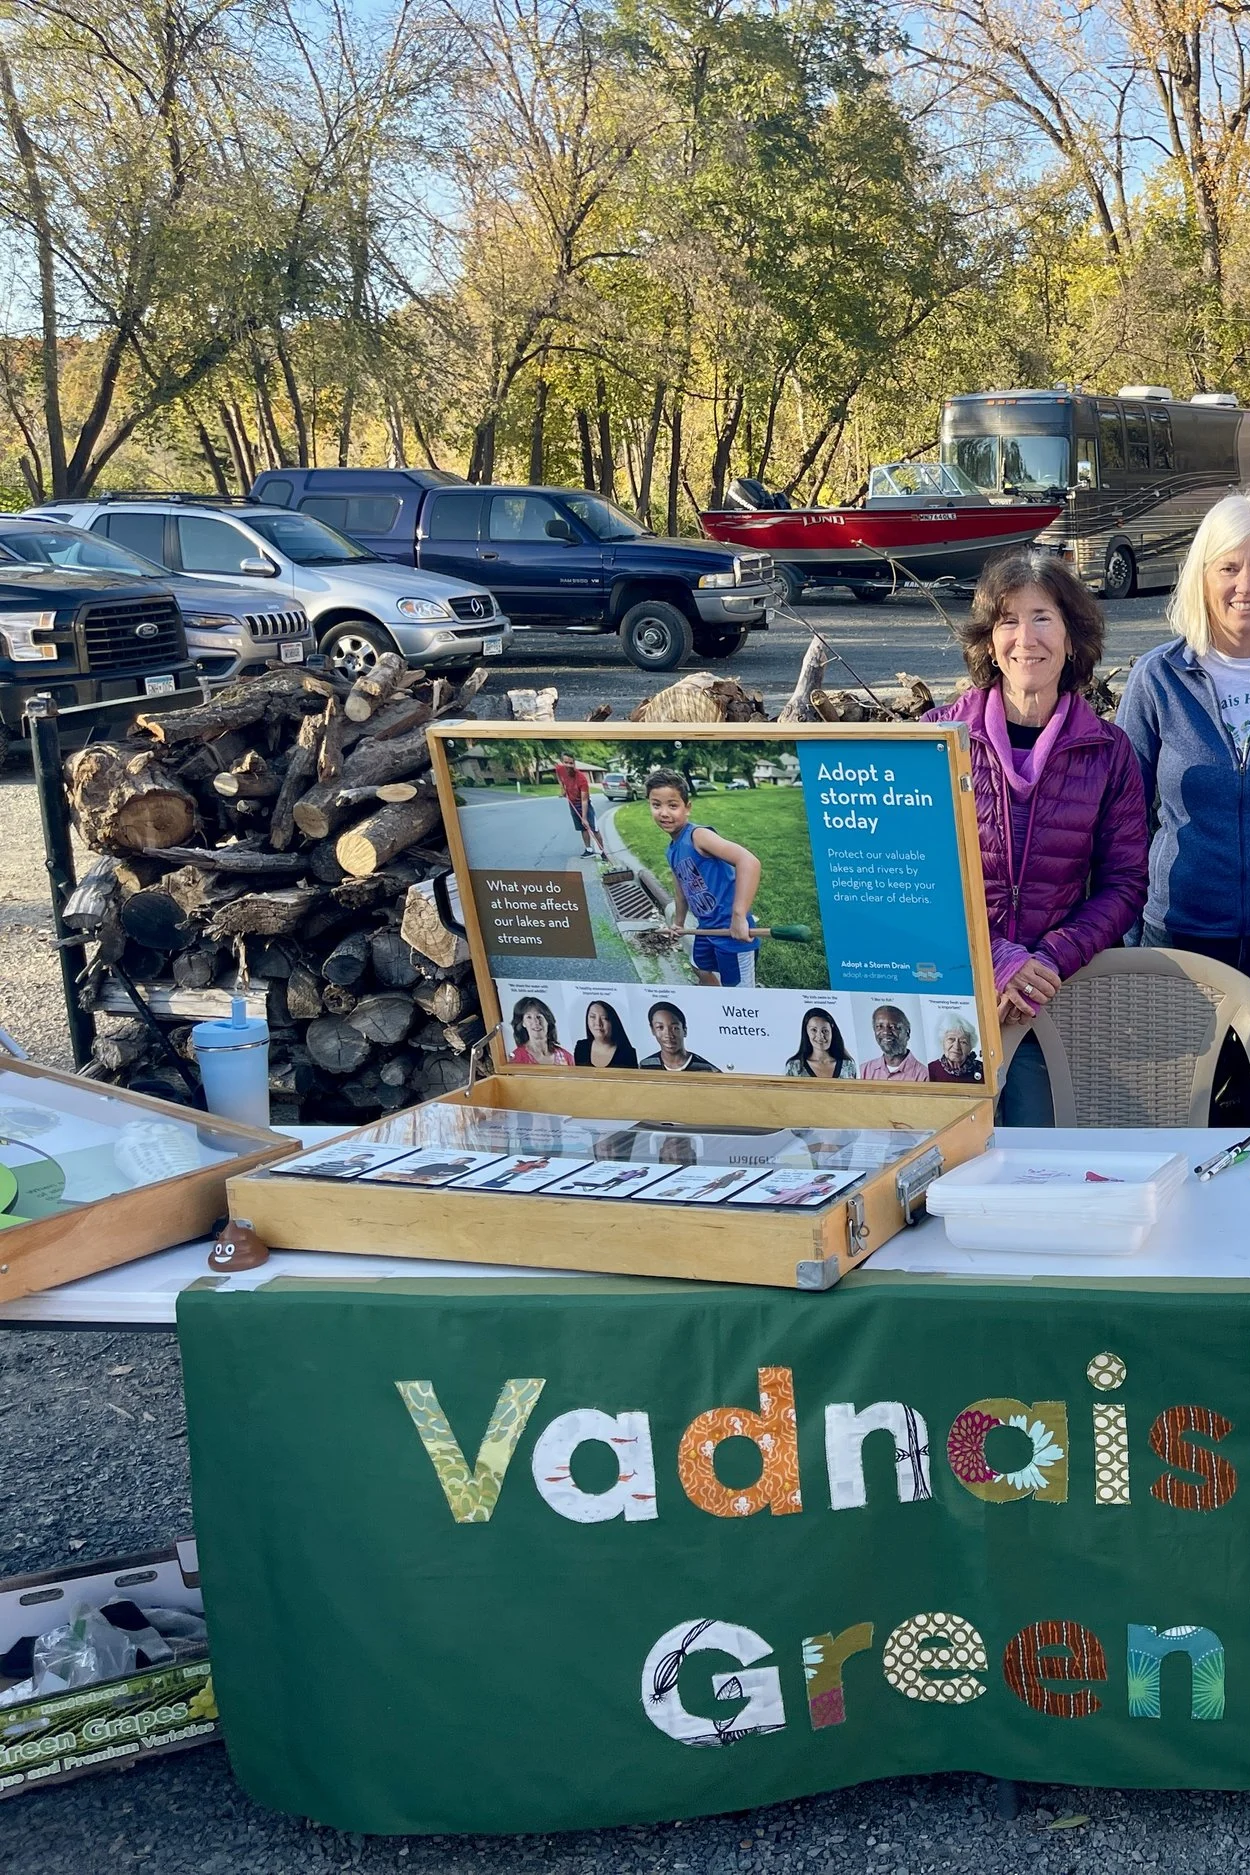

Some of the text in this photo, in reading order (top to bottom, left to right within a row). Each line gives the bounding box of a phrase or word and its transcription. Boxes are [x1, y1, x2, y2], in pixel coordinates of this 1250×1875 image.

[802, 515, 846, 527] LUND
[818, 762, 895, 786] Adopt a
[820, 786, 933, 806] storm drain
[823, 810, 879, 834] today
[827, 848, 926, 861] Protect our valuable
[829, 863, 919, 877] lakes and rivers by
[486, 880, 561, 895] What you do
[832, 878, 936, 891] pledging to keep your
[491, 897, 579, 911] at home affects
[833, 891, 932, 904] drain clear of debris.
[494, 915, 570, 928] our lakes and
[497, 933, 543, 945] streams
[841, 960, 862, 969] Adopt
[869, 961, 890, 969] Storm
[891, 961, 911, 969] Drain
[722, 1005, 760, 1018] Water
[719, 1025, 770, 1037] matters.
[395, 1352, 1238, 1524] Vadnais
[640, 1612, 1226, 1748] Green
[41, 1663, 211, 1715] Hand Selected Larg
[0, 1702, 189, 1767] reen Grapes
[27, 1760, 61, 1780] and
[64, 1742, 140, 1771] Premium
[141, 1722, 216, 1749] Varieties
